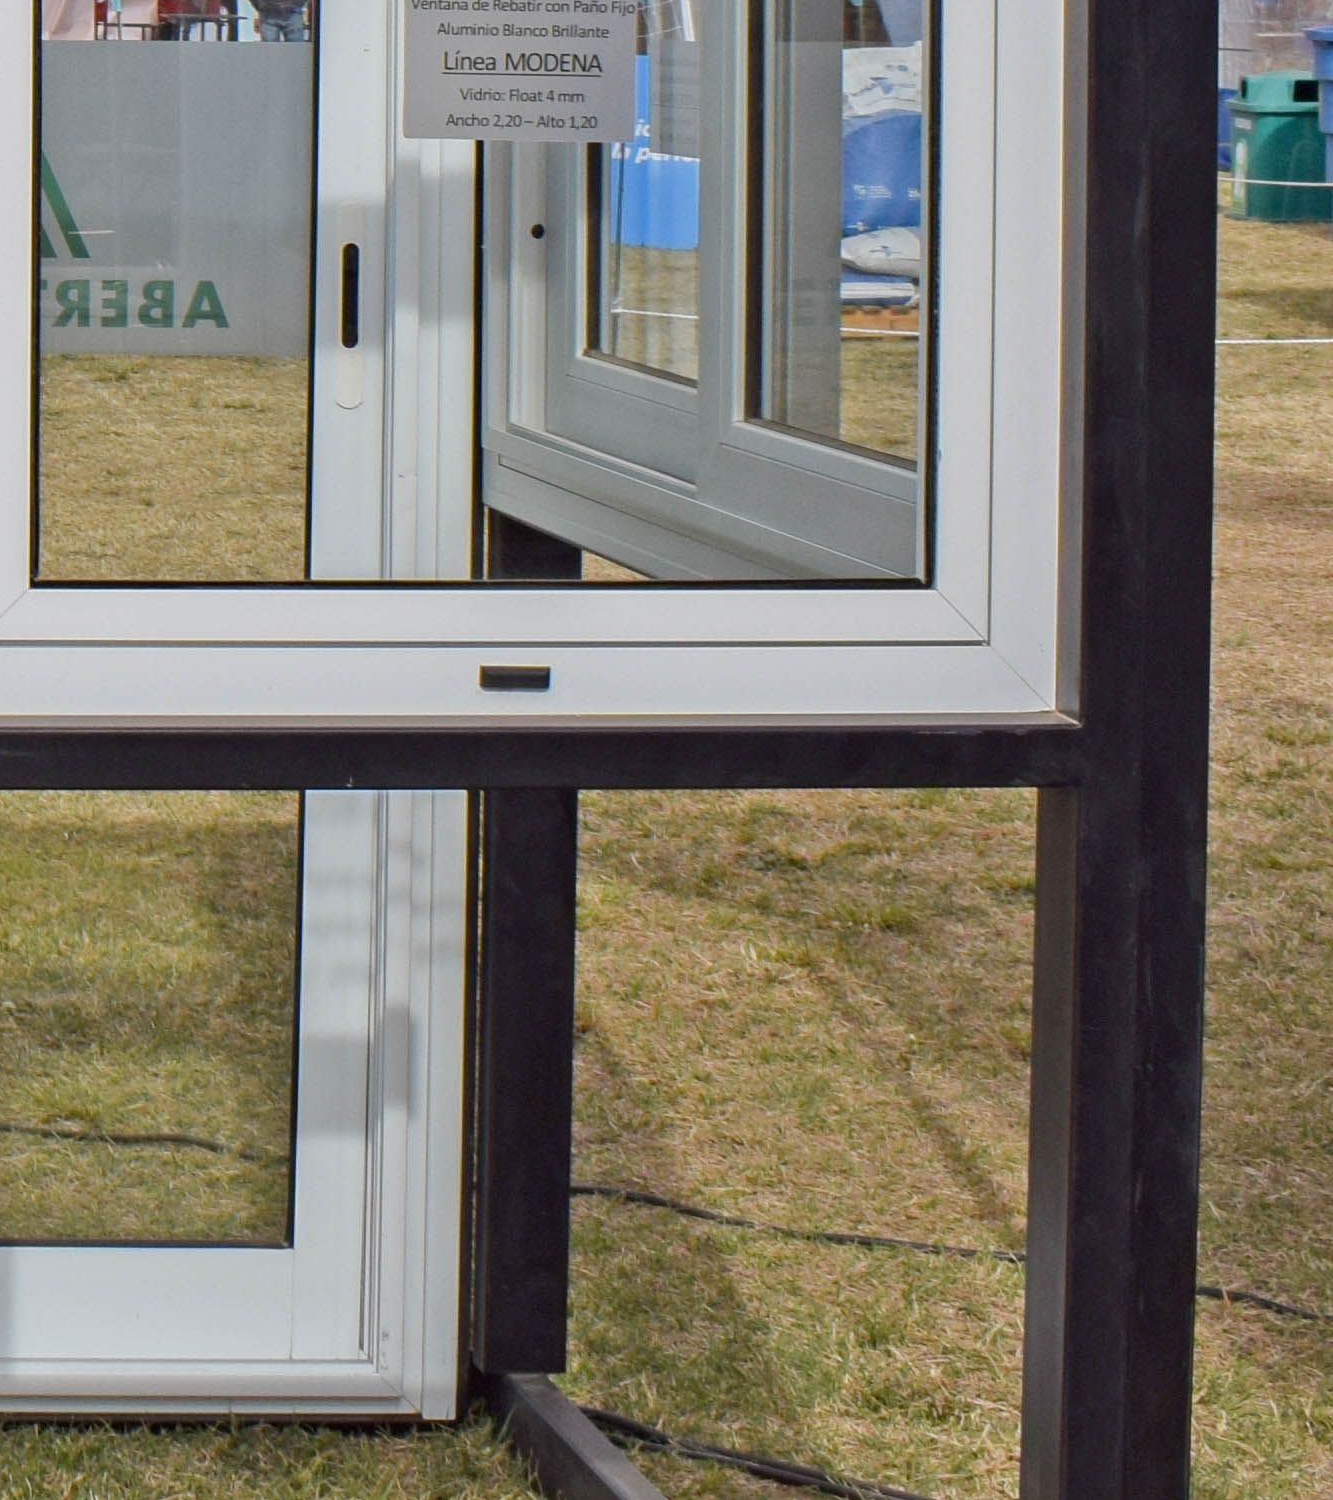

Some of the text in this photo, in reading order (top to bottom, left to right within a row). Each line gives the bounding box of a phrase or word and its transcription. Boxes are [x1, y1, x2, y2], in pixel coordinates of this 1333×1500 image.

[545, 1, 570, 13] con
[573, 0, 608, 14] Paño
[610, 0, 636, 17] Fijo
[436, 23, 610, 39] Aluminio Blanco Brillante
[442, 50, 603, 73] Línea MODENA
[459, 87, 586, 103] Vidrio: Float 4 mm
[445, 113, 490, 128] Ancho
[492, 114, 522, 129] 2,20
[535, 115, 565, 129] Alto
[569, 116, 598, 130] 1,20
